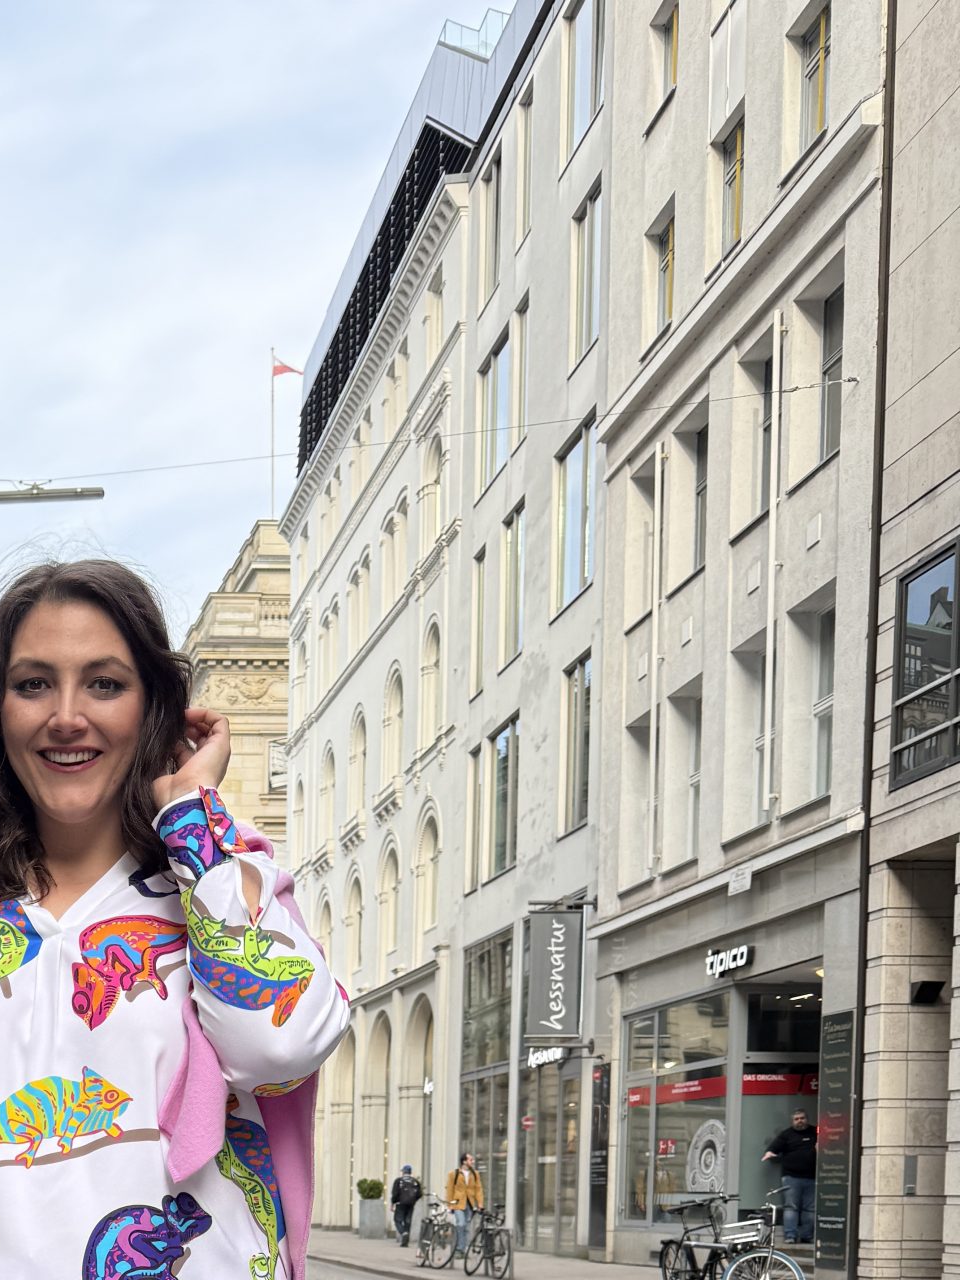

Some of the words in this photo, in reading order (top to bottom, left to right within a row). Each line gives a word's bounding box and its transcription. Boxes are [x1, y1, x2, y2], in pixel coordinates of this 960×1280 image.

[540, 917, 566, 1031] hessnatur
[705, 944, 748, 979] tipico
[742, 1073, 756, 1082] DAS
